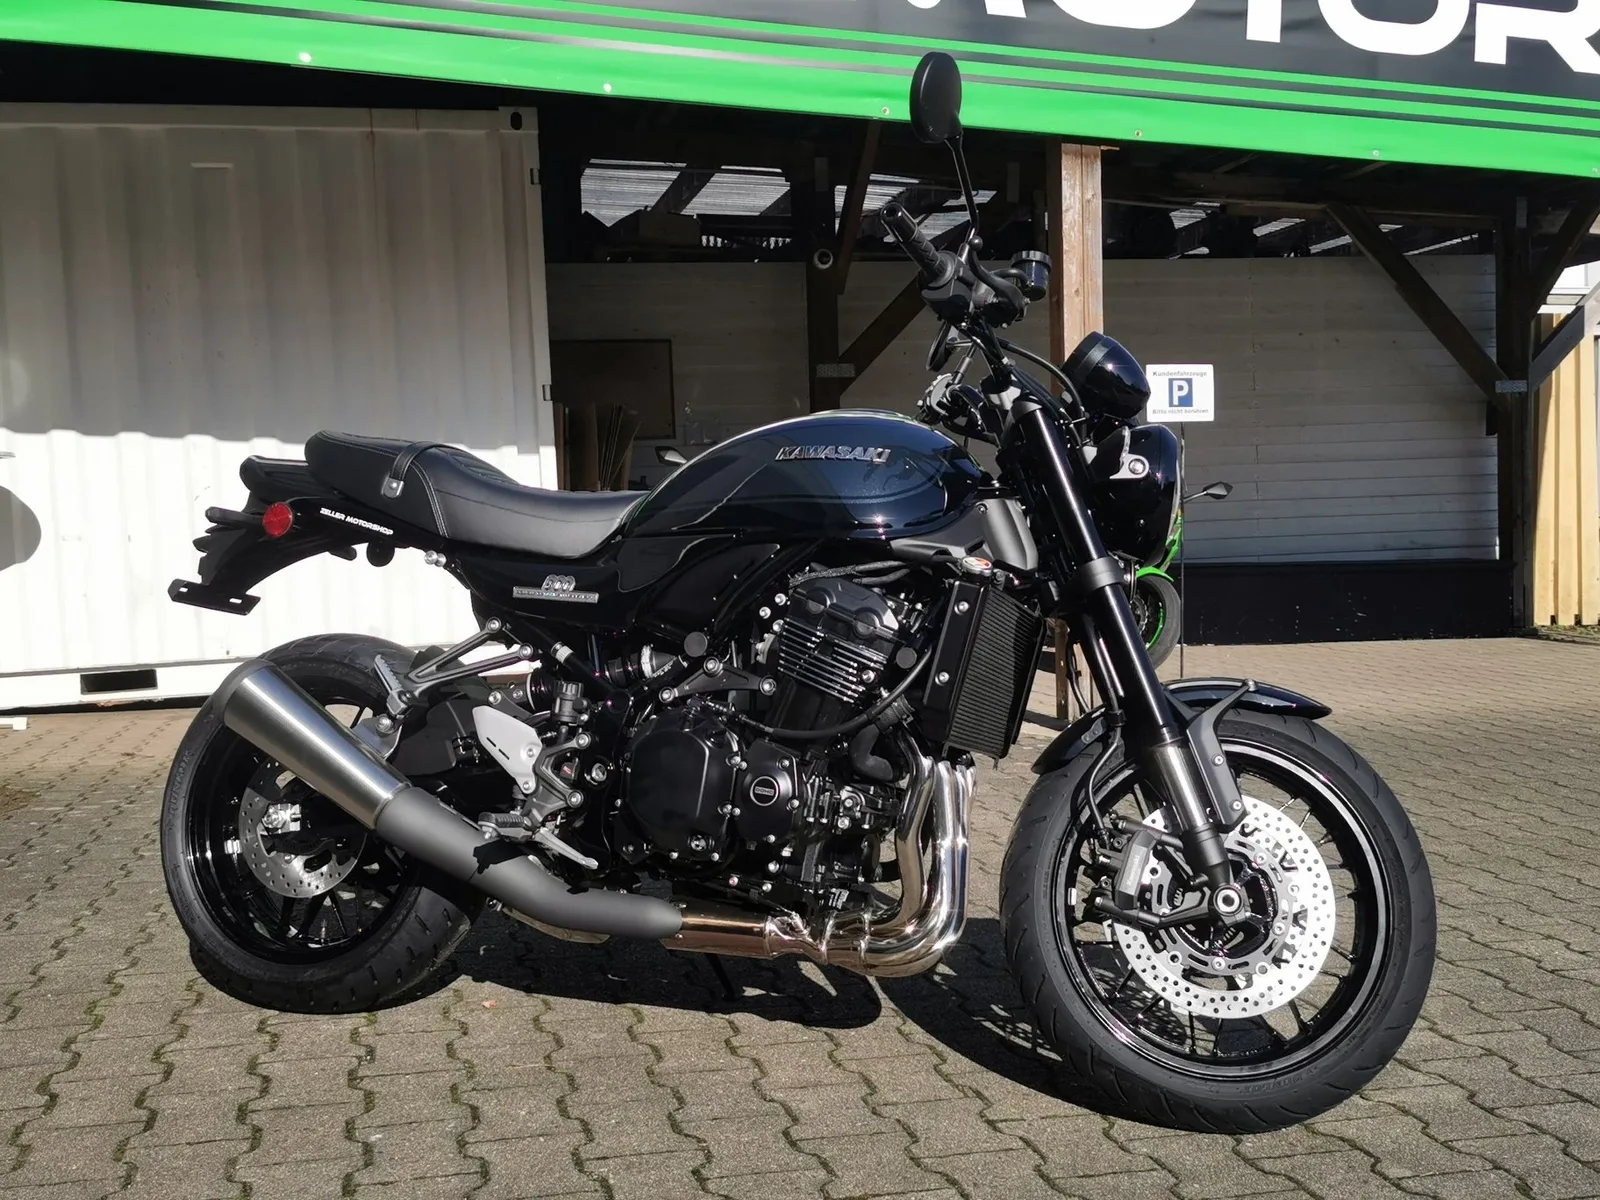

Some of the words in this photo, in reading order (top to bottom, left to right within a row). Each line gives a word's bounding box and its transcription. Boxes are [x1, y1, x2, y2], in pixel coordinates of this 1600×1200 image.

[1172, 380, 1189, 406] P
[774, 445, 892, 463] KAWASAKI
[319, 507, 346, 521] ZELLER
[345, 515, 394, 535] MOTORSHOP
